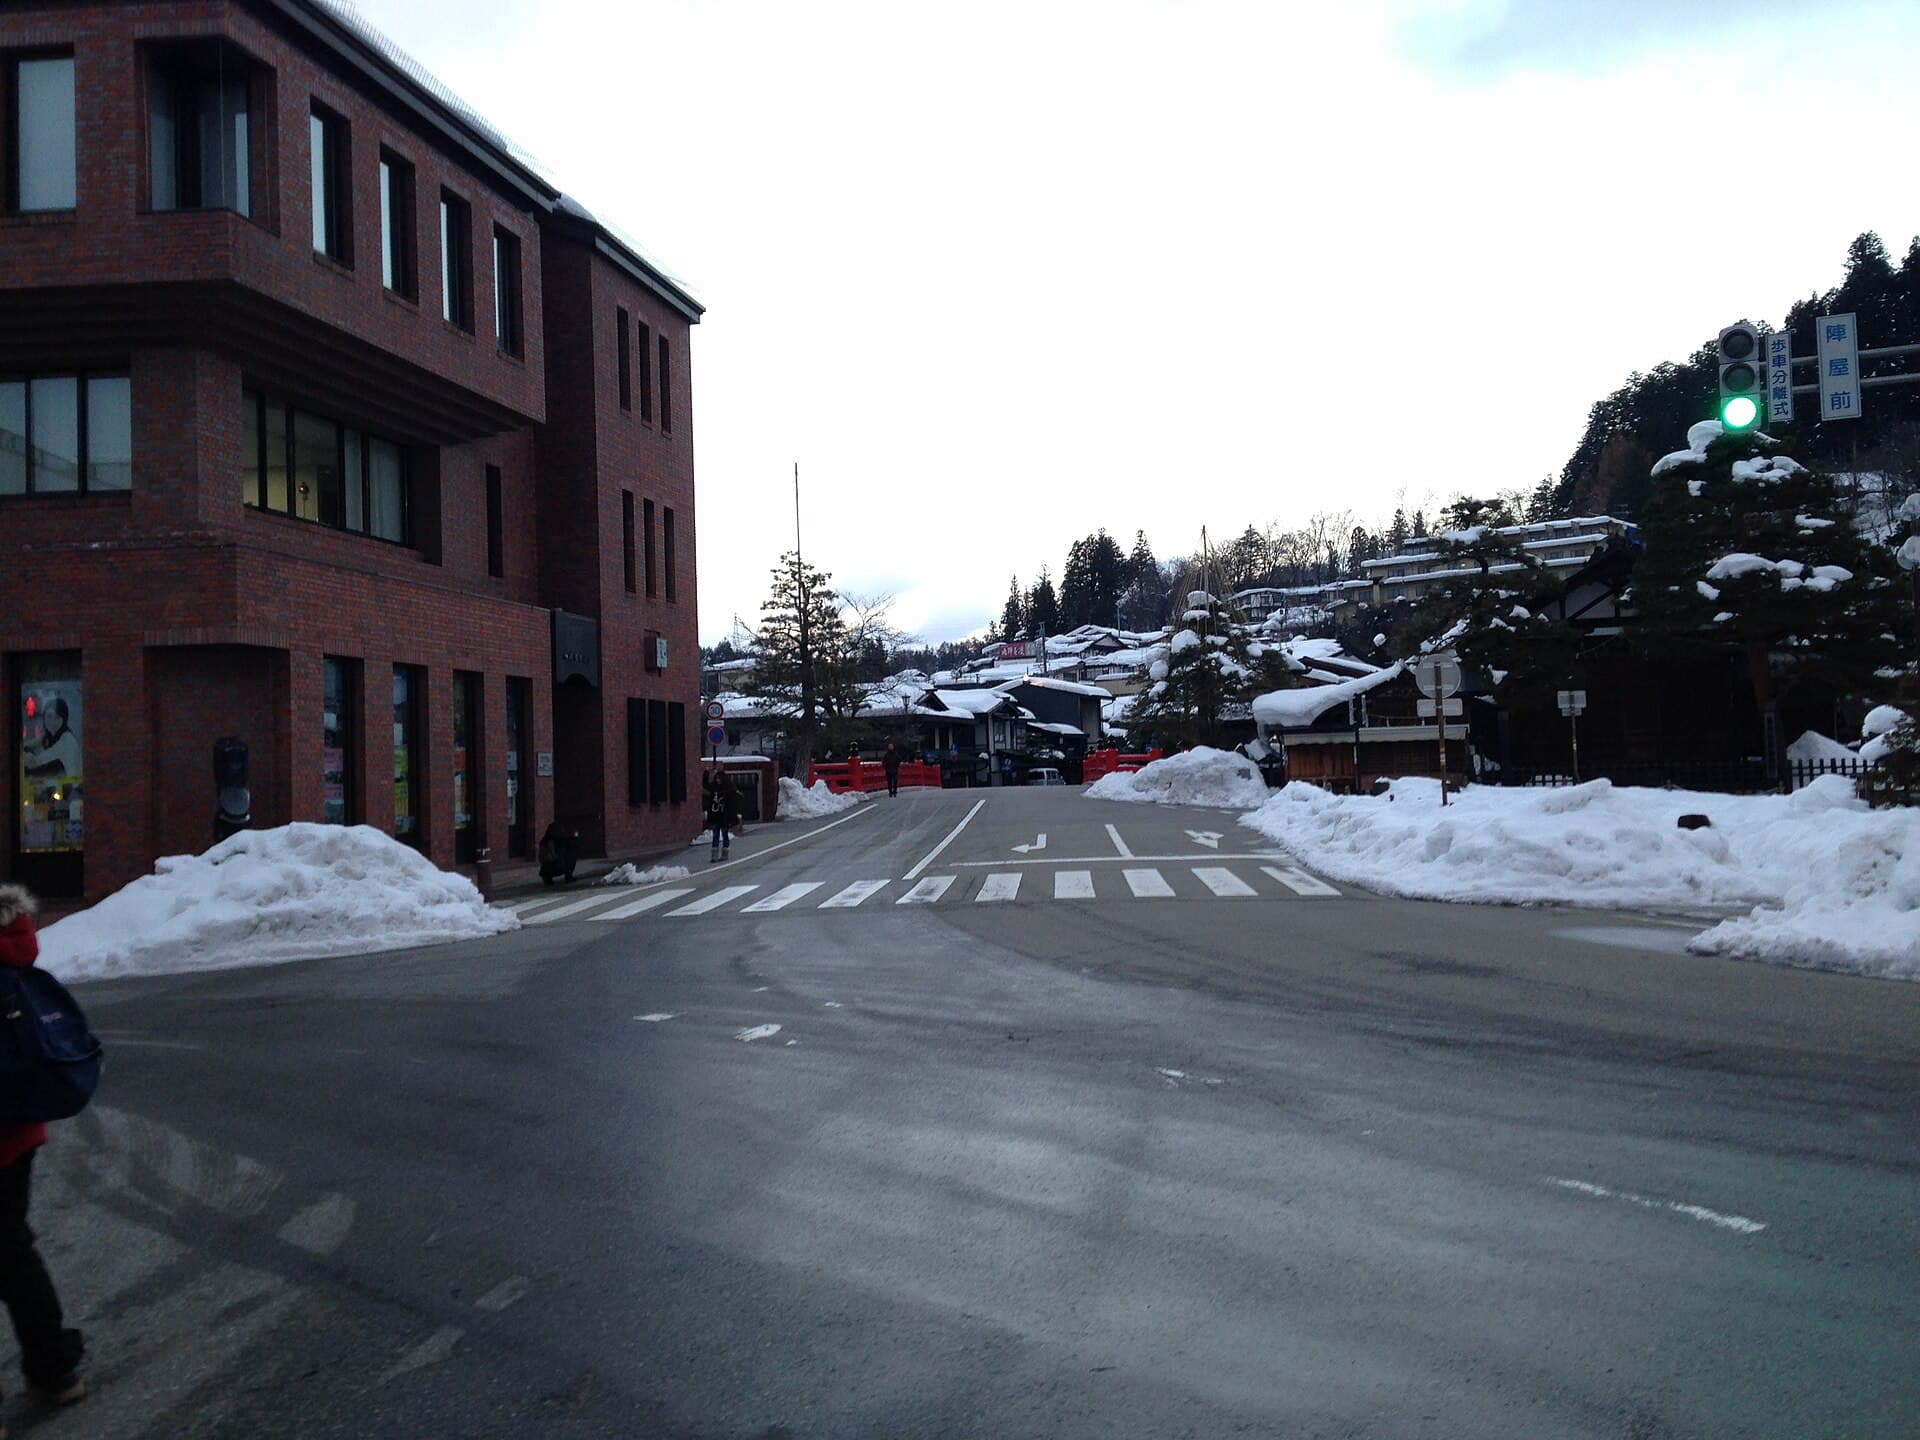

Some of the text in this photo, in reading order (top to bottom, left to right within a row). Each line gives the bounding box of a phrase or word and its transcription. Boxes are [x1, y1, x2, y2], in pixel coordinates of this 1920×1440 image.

[1771, 339, 1788, 416] 歩車分離式
[1825, 324, 1850, 411] 陣屋前
